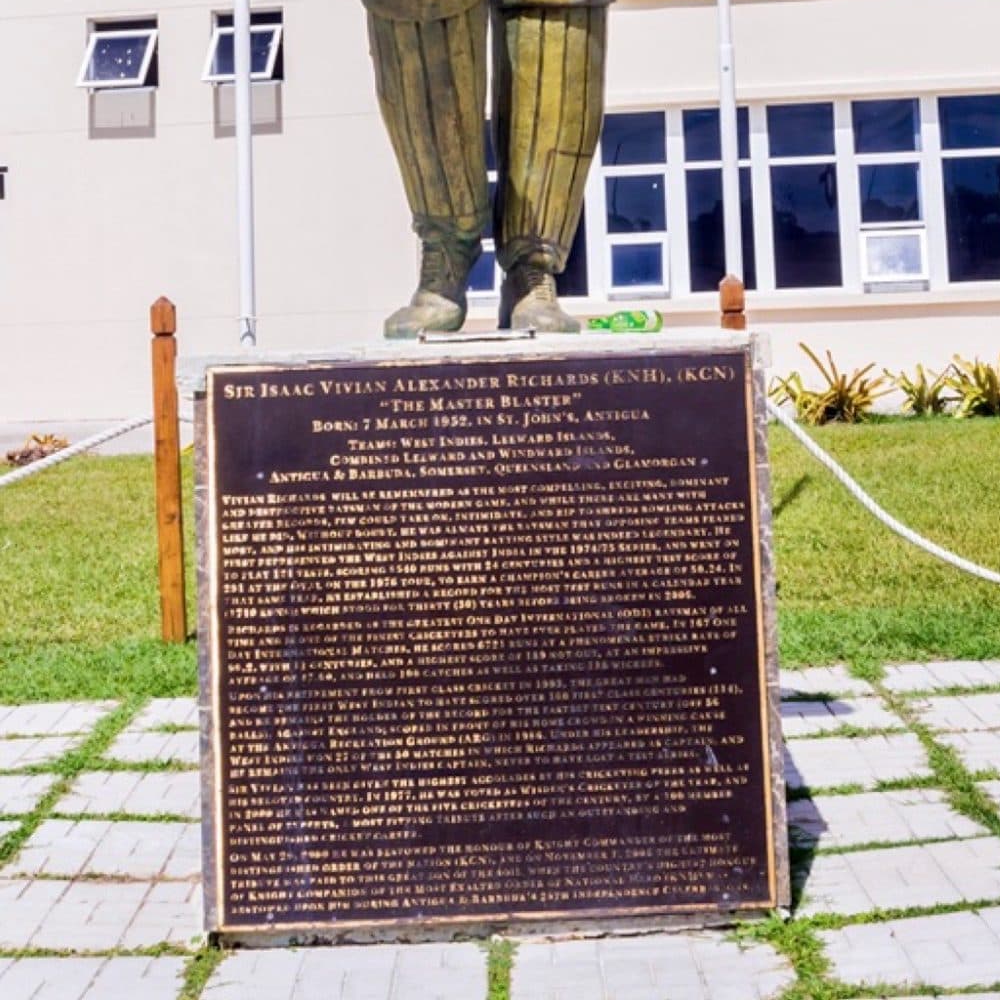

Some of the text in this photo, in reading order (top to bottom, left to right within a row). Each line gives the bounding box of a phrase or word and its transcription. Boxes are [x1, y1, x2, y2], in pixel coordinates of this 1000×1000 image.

[223, 383, 256, 399] SIR
[257, 382, 316, 398] ISAAC
[318, 378, 387, 395] VIVIAN
[392, 375, 502, 392] ALEXANDER
[505, 371, 599, 388] RICHARDS
[428, 396, 496, 411] MASTER
[361, 418, 371, 430] 7
[374, 416, 429, 430] MARCH
[399, 436, 438, 449] WEST
[498, 446, 574, 459] WINDWARD
